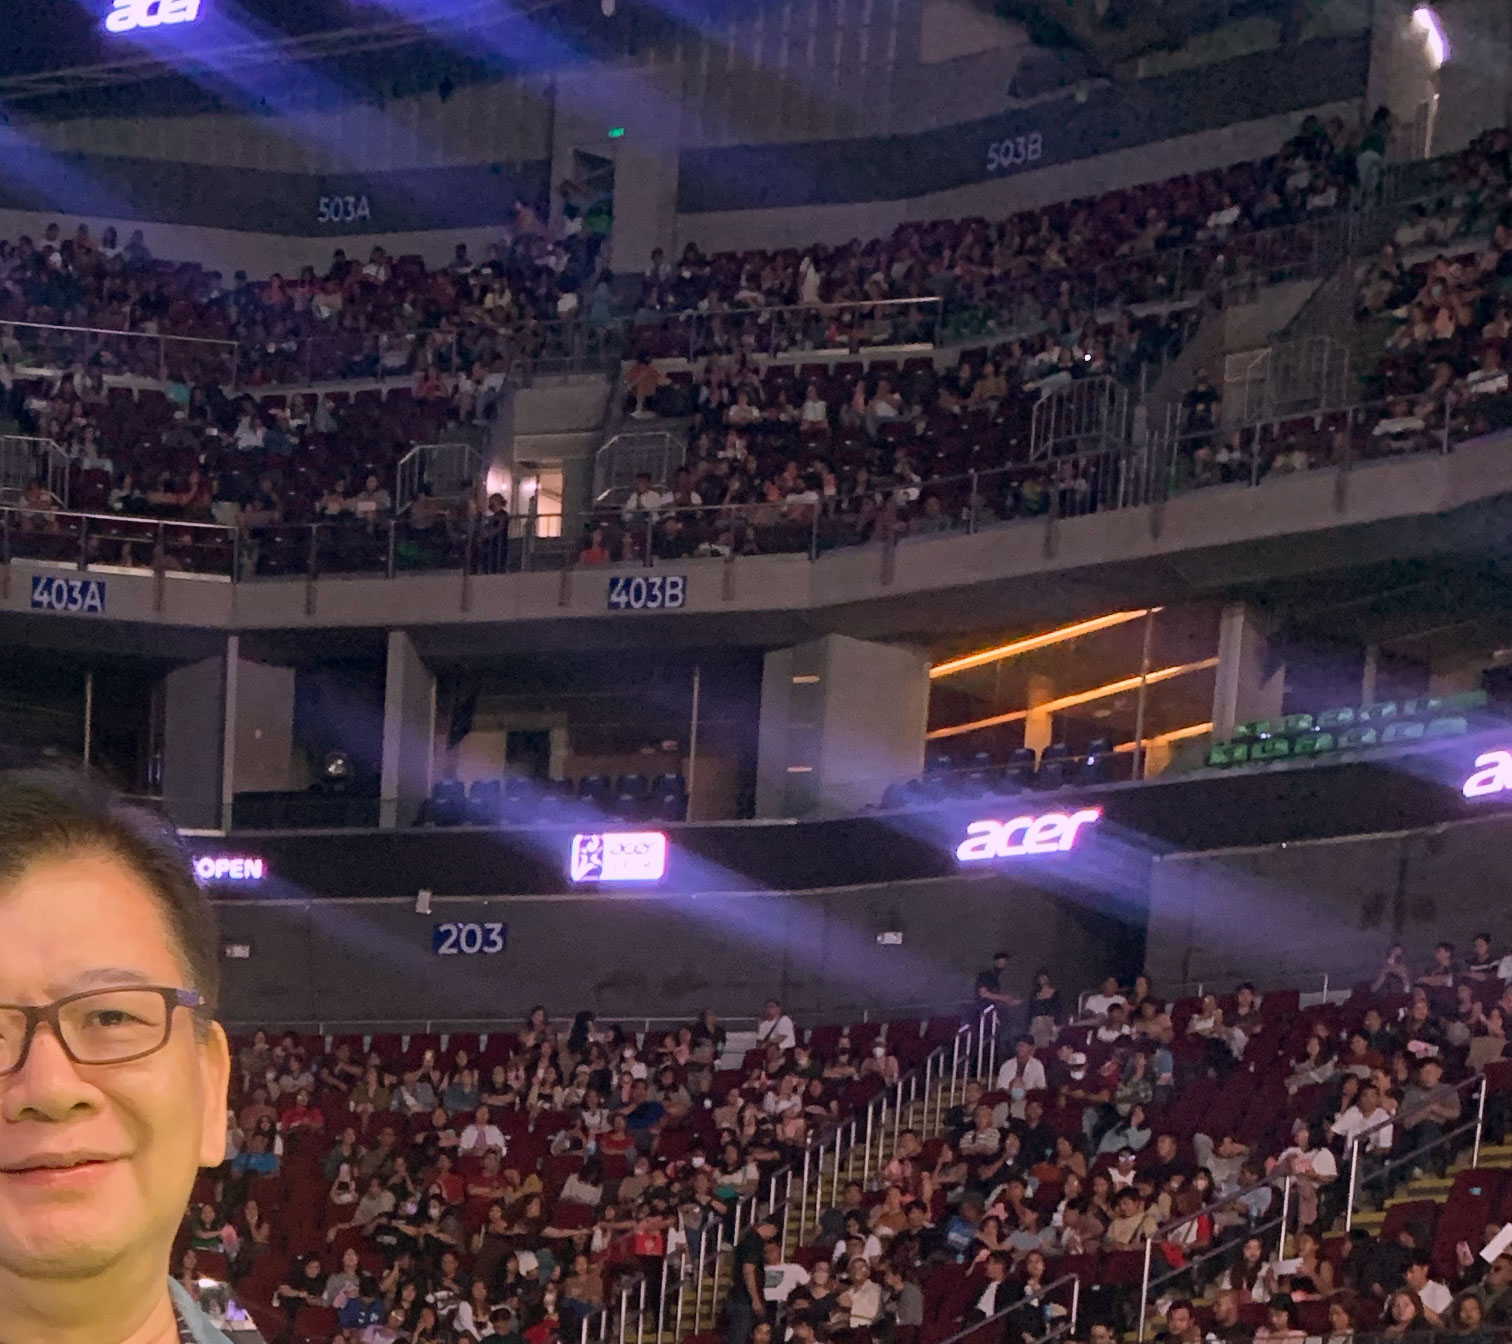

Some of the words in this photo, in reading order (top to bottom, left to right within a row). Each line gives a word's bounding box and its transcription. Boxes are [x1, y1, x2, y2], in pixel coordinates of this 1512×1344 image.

[987, 133, 1042, 170] 503B
[318, 196, 370, 222] 503A
[34, 576, 103, 613] 403A
[610, 577, 684, 608] 403B
[956, 810, 1100, 861] acer
[438, 923, 503, 954] 203
